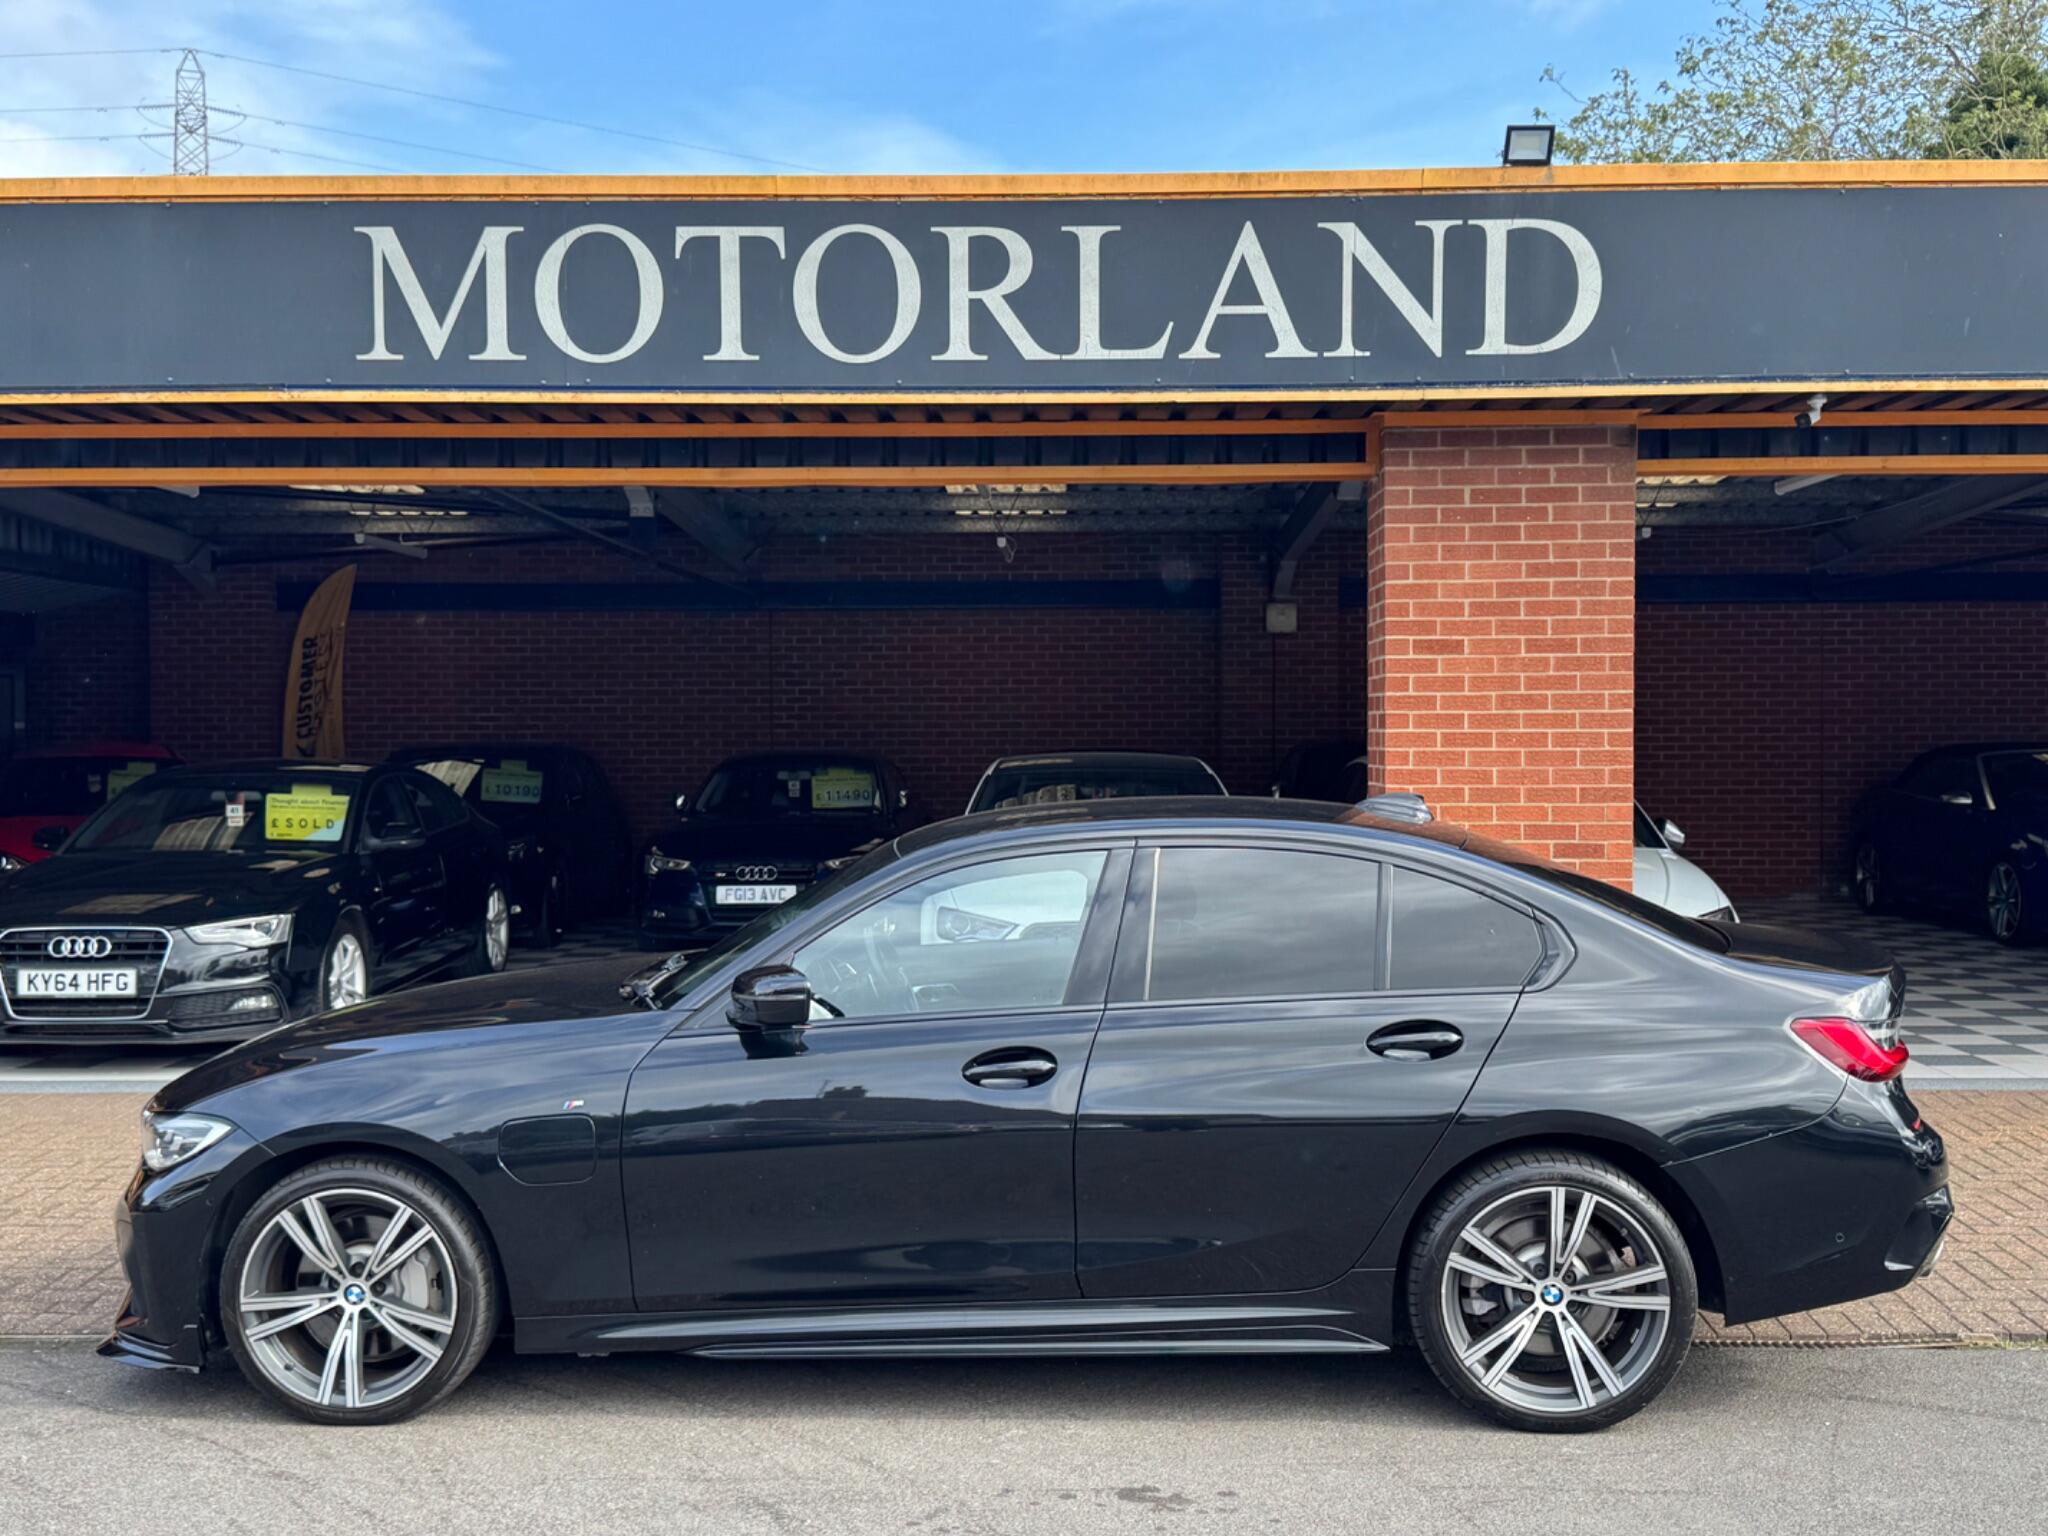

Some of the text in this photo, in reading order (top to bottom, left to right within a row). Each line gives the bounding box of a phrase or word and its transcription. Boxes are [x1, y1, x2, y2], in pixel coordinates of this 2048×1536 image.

[353, 218, 1602, 364] MOTORLAND
[296, 636, 318, 740] CUSTOMER
[725, 887, 756, 901] FG13
[27, 973, 129, 992] KY64 HFG
